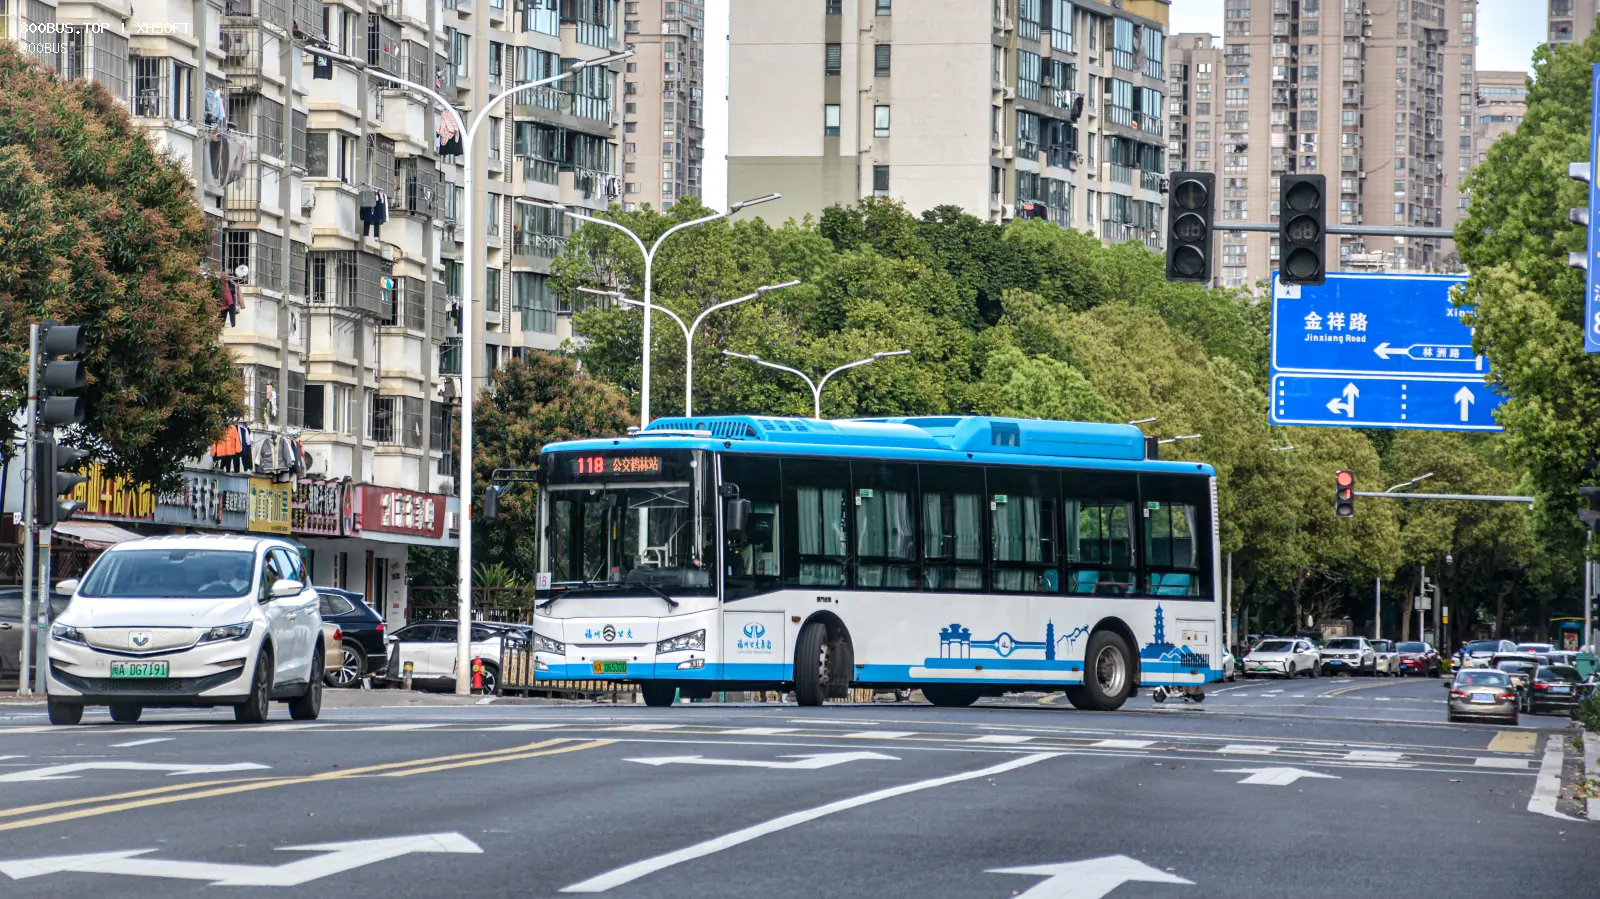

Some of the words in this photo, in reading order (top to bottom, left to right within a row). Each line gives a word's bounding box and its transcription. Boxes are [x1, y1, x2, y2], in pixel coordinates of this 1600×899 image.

[1303, 310, 1368, 331] 金祥路
[1304, 333, 1344, 344] Jinxiang
[1345, 334, 1367, 343] Road
[1422, 346, 1460, 359] 林洲路
[577, 456, 604, 474] 118
[130, 663, 166, 676] DG7191
